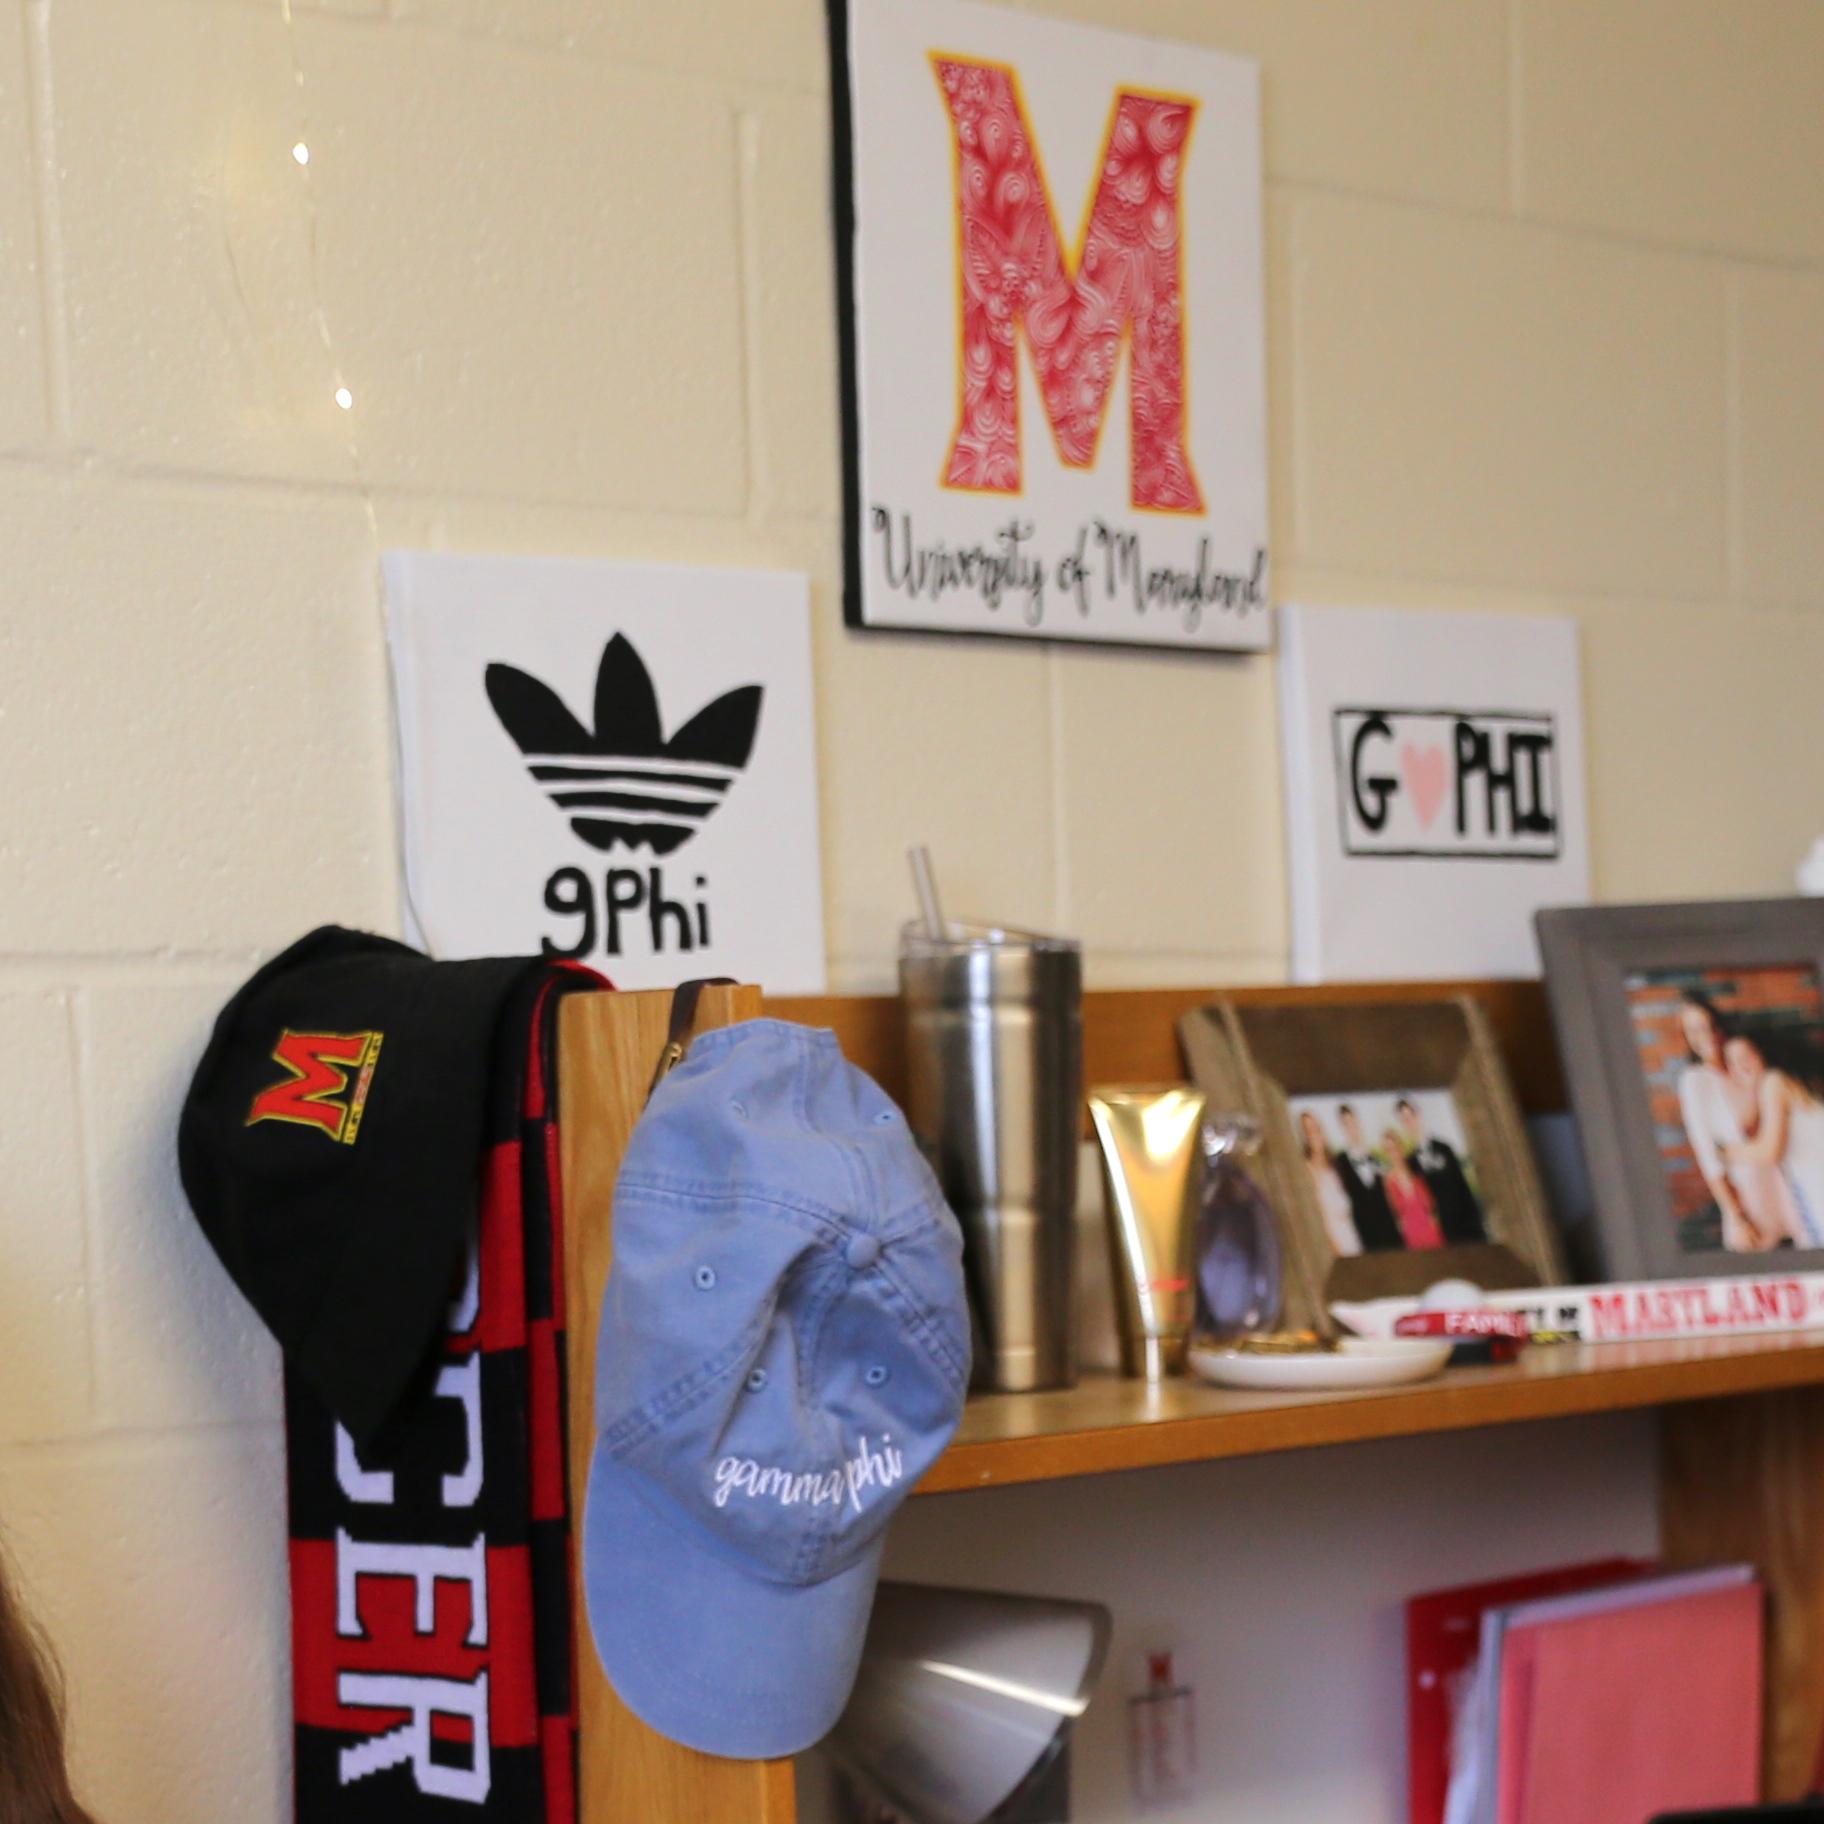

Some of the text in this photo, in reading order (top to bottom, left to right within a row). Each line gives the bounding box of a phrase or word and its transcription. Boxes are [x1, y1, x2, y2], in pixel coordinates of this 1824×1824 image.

[926, 50, 1208, 517] M
[872, 506, 1267, 633] University of Maryland
[1349, 719, 1558, 836] G PHI
[244, 1028, 378, 1146] M
[1588, 1279, 1810, 1341] MARYLAND
[331, 1246, 493, 1806] CER
